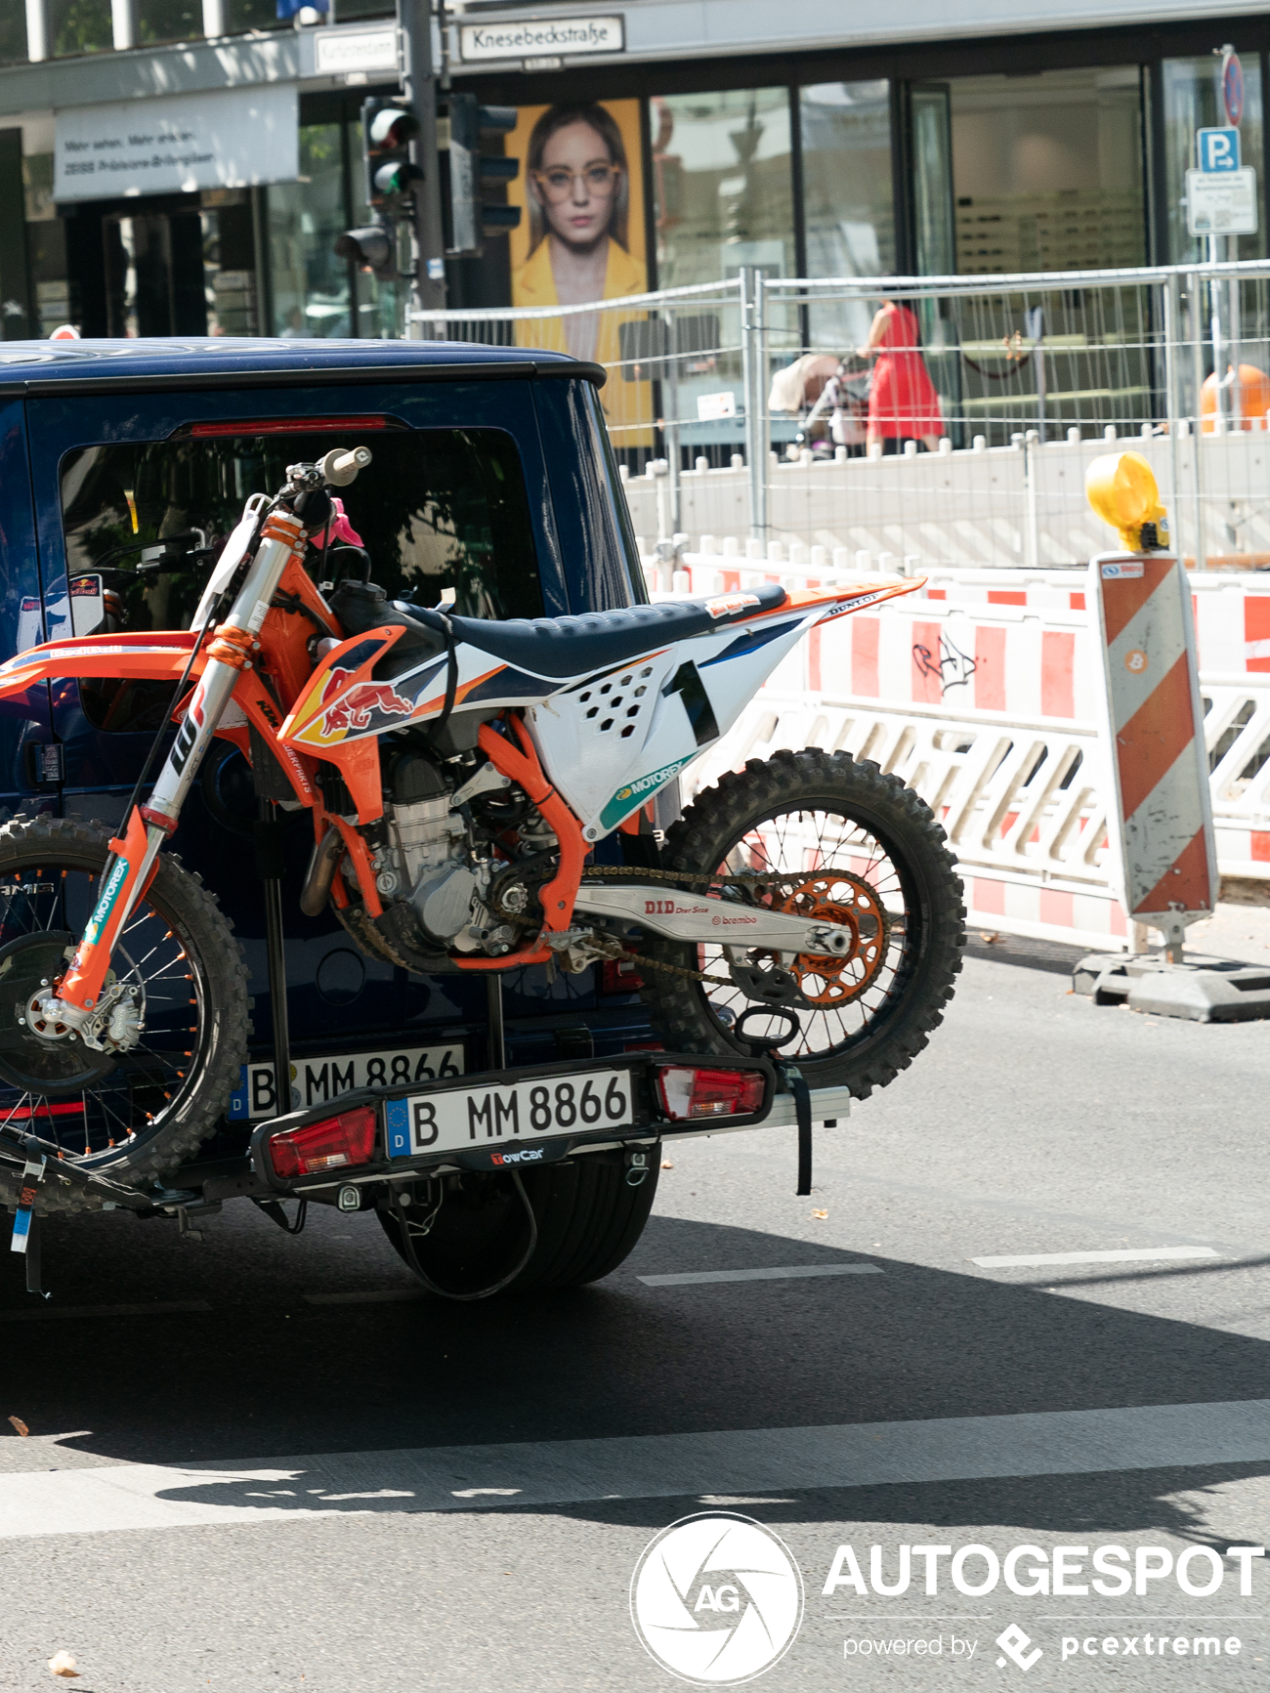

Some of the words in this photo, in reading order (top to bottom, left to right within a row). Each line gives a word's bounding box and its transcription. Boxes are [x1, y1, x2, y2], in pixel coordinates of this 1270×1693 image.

[473, 23, 608, 48] Knesebeckstraße
[1208, 133, 1230, 168] P
[829, 592, 880, 615] DUNLOP
[256, 700, 280, 728] KTM
[661, 659, 720, 747] 1
[282, 743, 313, 794] WERPARTS
[630, 761, 683, 794] MOTOREX
[93, 859, 128, 923] MOTOREX
[645, 900, 675, 914] DID
[722, 915, 757, 925] brembo
[232, 1099, 242, 1111] D
[252, 1068, 276, 1112] B
[305, 1060, 355, 1106] MM
[366, 1050, 460, 1087] 8866
[394, 1134, 404, 1148] D
[413, 1101, 439, 1147] B
[467, 1090, 520, 1140] MM
[529, 1076, 627, 1131] 8866
